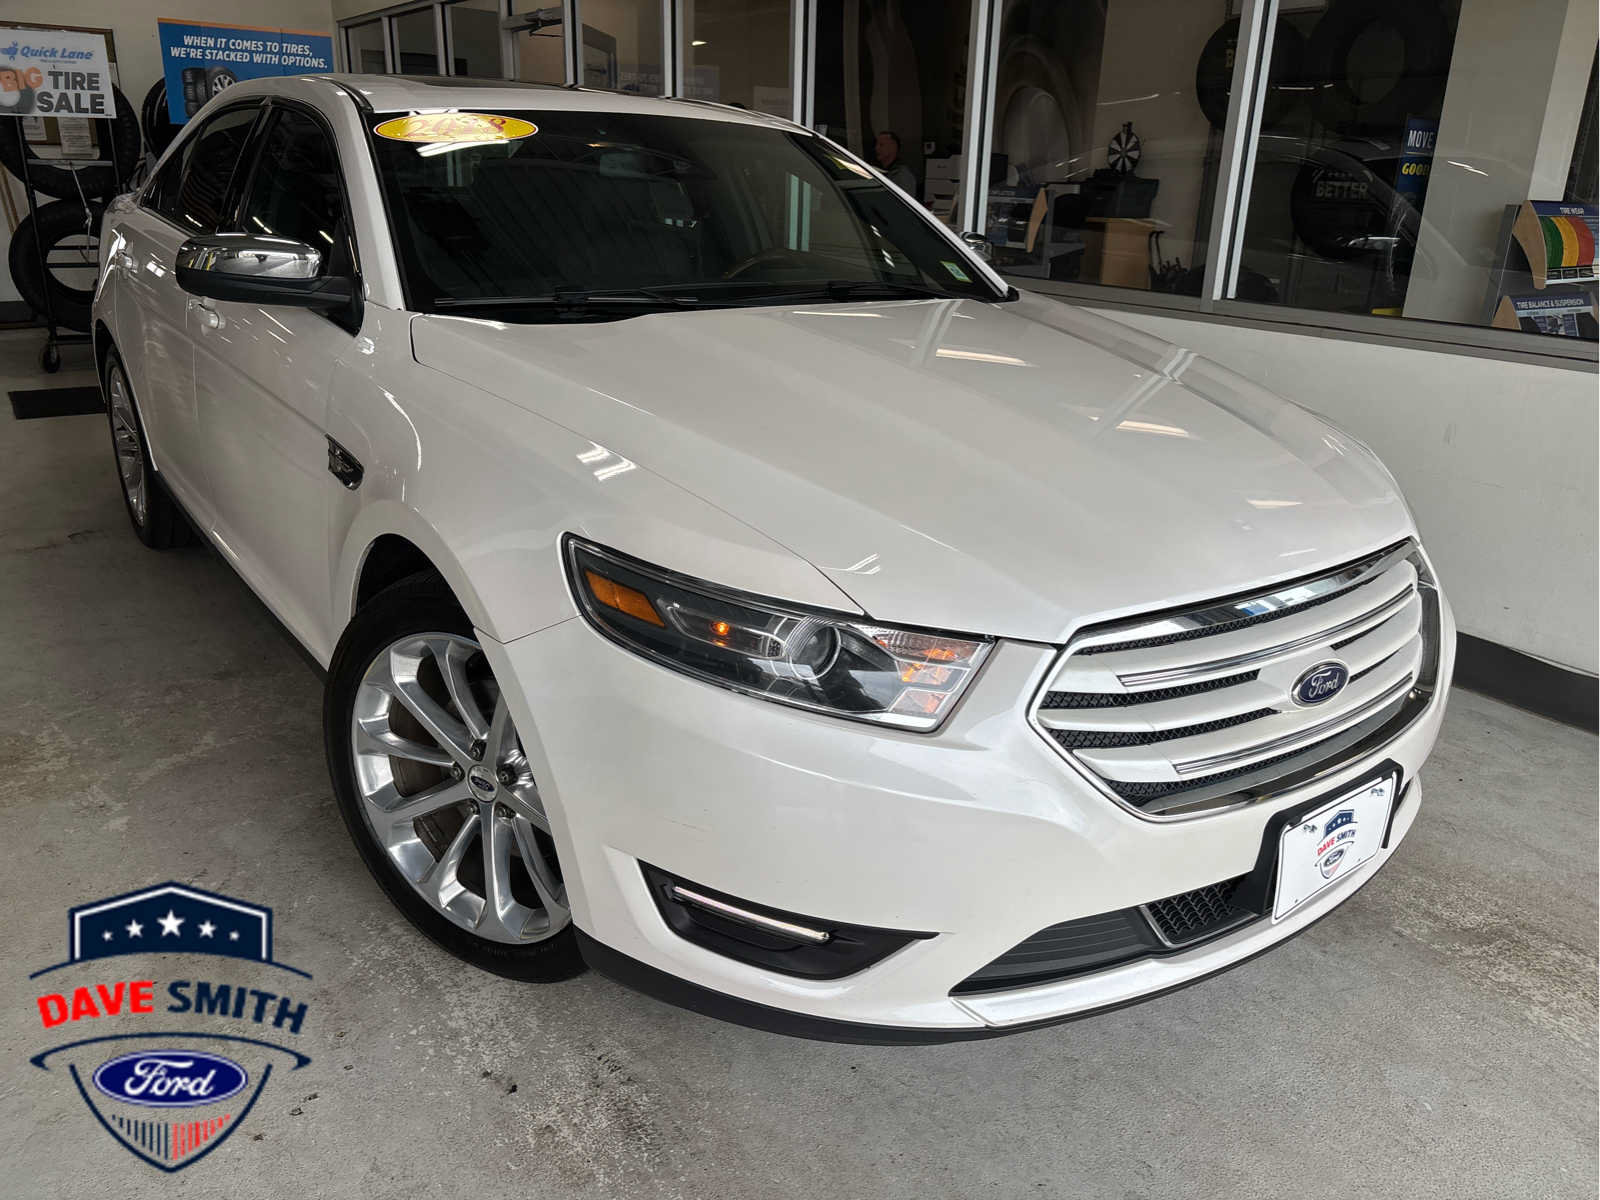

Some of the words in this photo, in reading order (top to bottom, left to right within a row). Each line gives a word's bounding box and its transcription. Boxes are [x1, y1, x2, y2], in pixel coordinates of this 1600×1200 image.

[20, 45, 58, 58] Quick
[60, 48, 94, 60] Lane
[170, 46, 203, 59] WE'RE
[204, 48, 250, 62] STACKED
[252, 53, 279, 65] WITH
[281, 54, 328, 69] OPTIONS.
[183, 35, 215, 48] WHEN
[217, 38, 227, 49] IT
[228, 39, 264, 52] COMES
[266, 42, 279, 53] TO
[281, 43, 313, 57] TIRES,
[0, 66, 44, 92] BIG
[48, 70, 100, 91] TIRE
[36, 91, 105, 114] SALE
[1316, 181, 1369, 199] BETTER
[1516, 301, 1529, 309] TIRE
[1308, 673, 1339, 697] Ford
[1317, 837, 1336, 856] DAVE
[1336, 829, 1356, 842] SMITH
